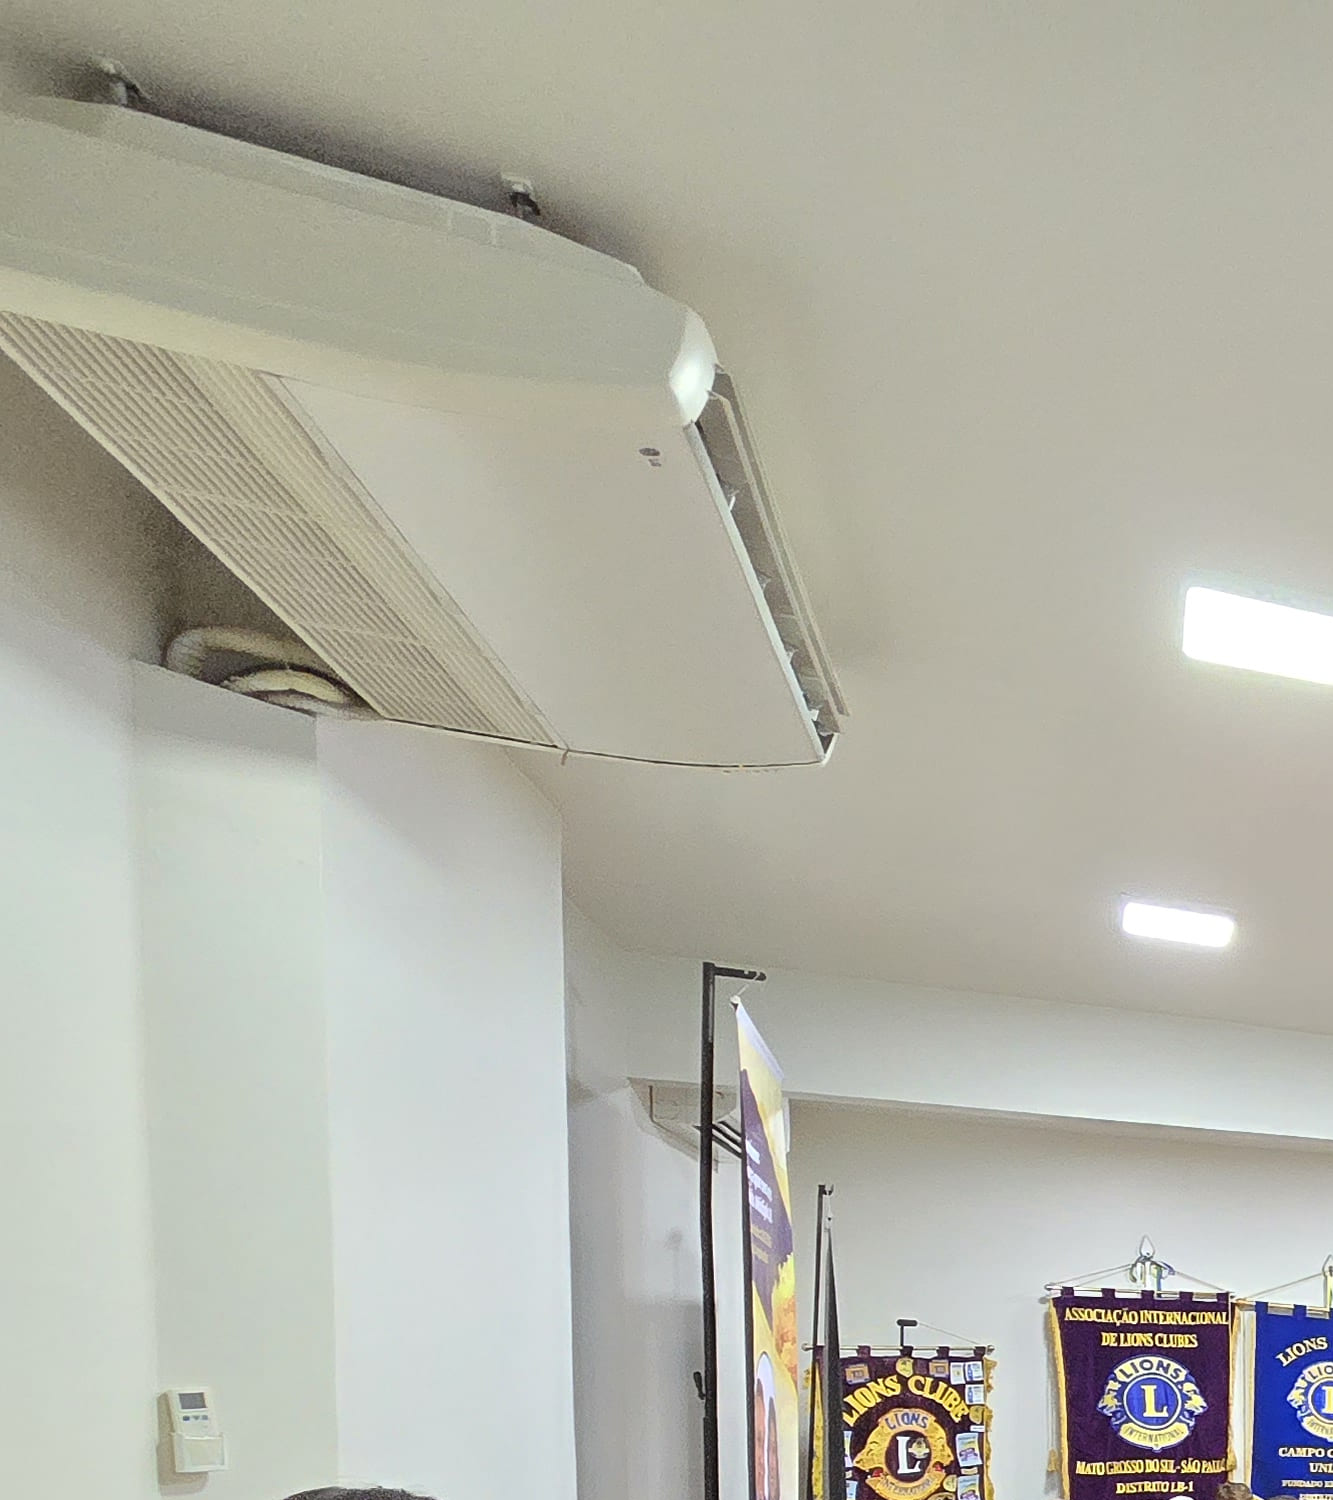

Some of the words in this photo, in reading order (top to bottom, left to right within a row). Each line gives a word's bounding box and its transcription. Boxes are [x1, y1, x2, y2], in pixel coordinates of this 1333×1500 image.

[1064, 1307, 1139, 1327] ASSOCIAÇÃO
[1140, 1310, 1229, 1325] INTERNACIONAL
[1101, 1332, 1118, 1346] DE
[1119, 1333, 1153, 1347] LIONS
[1154, 1333, 1198, 1348] CLUBES
[1275, 1337, 1328, 1367] LIONS
[1118, 1359, 1182, 1380] LIONS
[842, 1375, 901, 1427] LIONS
[908, 1375, 969, 1423] CLUBE
[1140, 1385, 1169, 1417] L
[884, 1413, 928, 1430] LIONS
[1278, 1447, 1325, 1458] CAMPO
[1076, 1460, 1105, 1475] MATO
[1106, 1460, 1144, 1475] GROSSO
[1144, 1458, 1160, 1473] DO
[1181, 1457, 1201, 1474] SÃO
[1115, 1481, 1170, 1494] DISTRITO
[1170, 1481, 1194, 1493] LB-1
